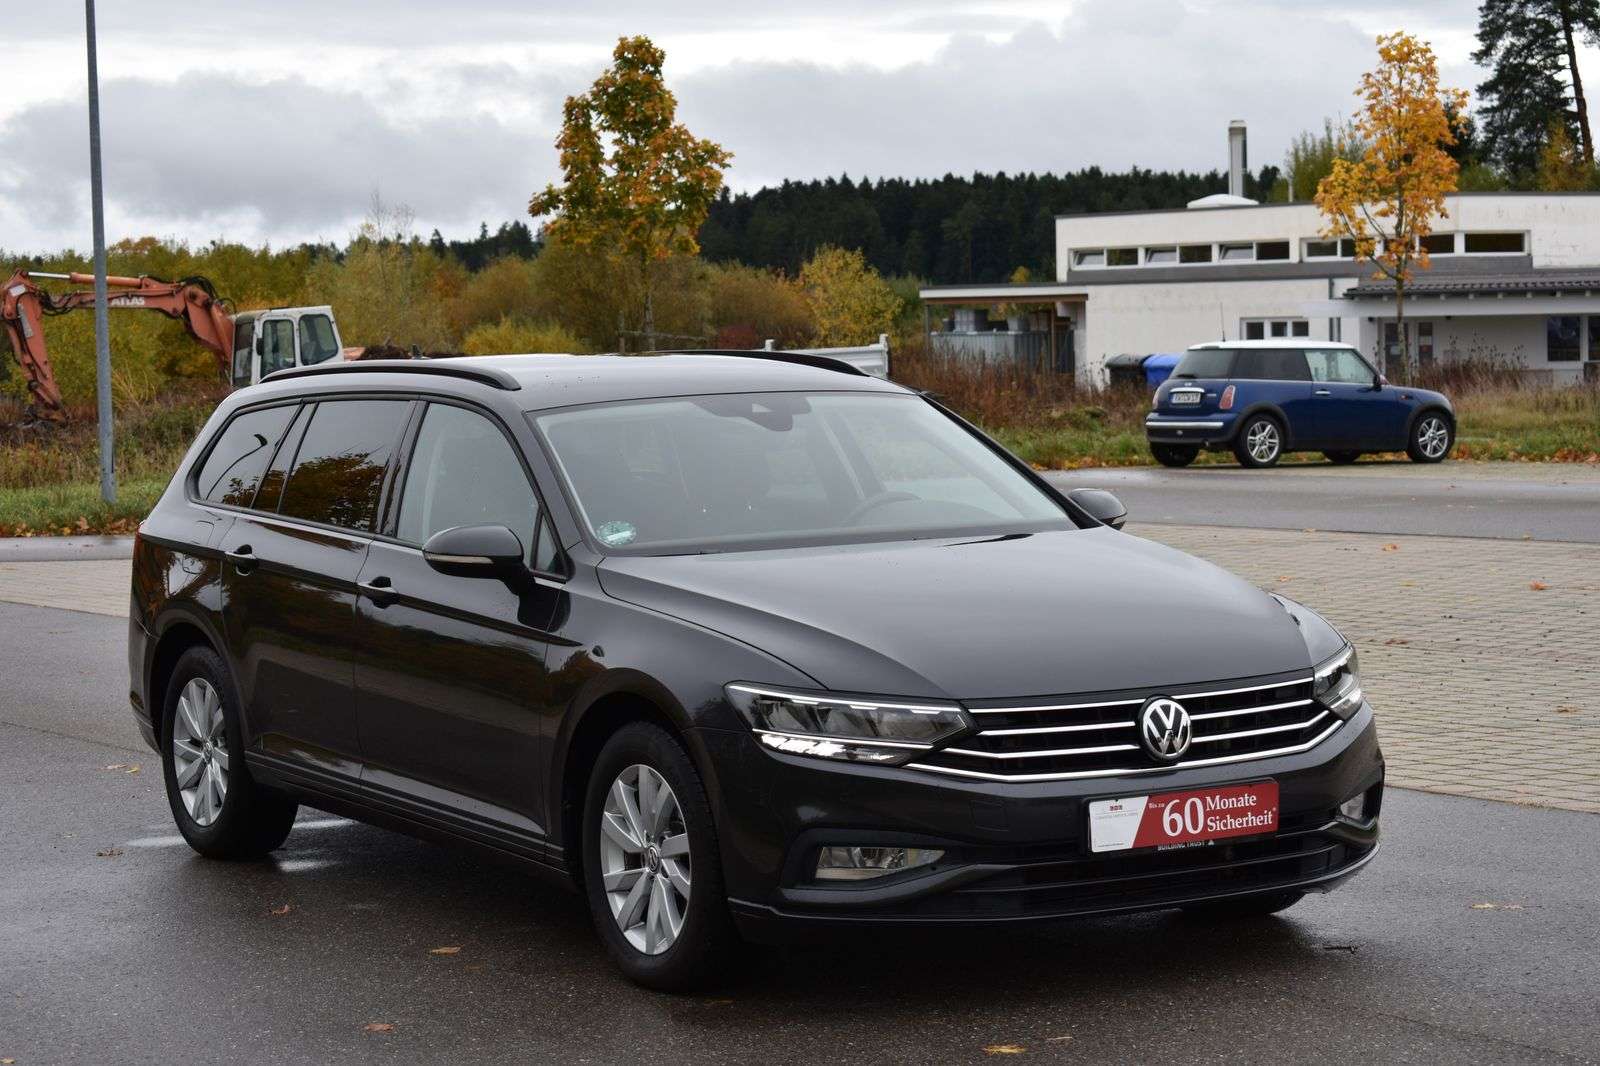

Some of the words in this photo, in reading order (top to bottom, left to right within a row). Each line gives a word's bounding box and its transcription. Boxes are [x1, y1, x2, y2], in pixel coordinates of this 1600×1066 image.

[111, 297, 145, 306] ATLAS
[1163, 797, 1204, 837] 60
[1206, 792, 1257, 811] Monate
[1207, 811, 1273, 832] Sicherheit
